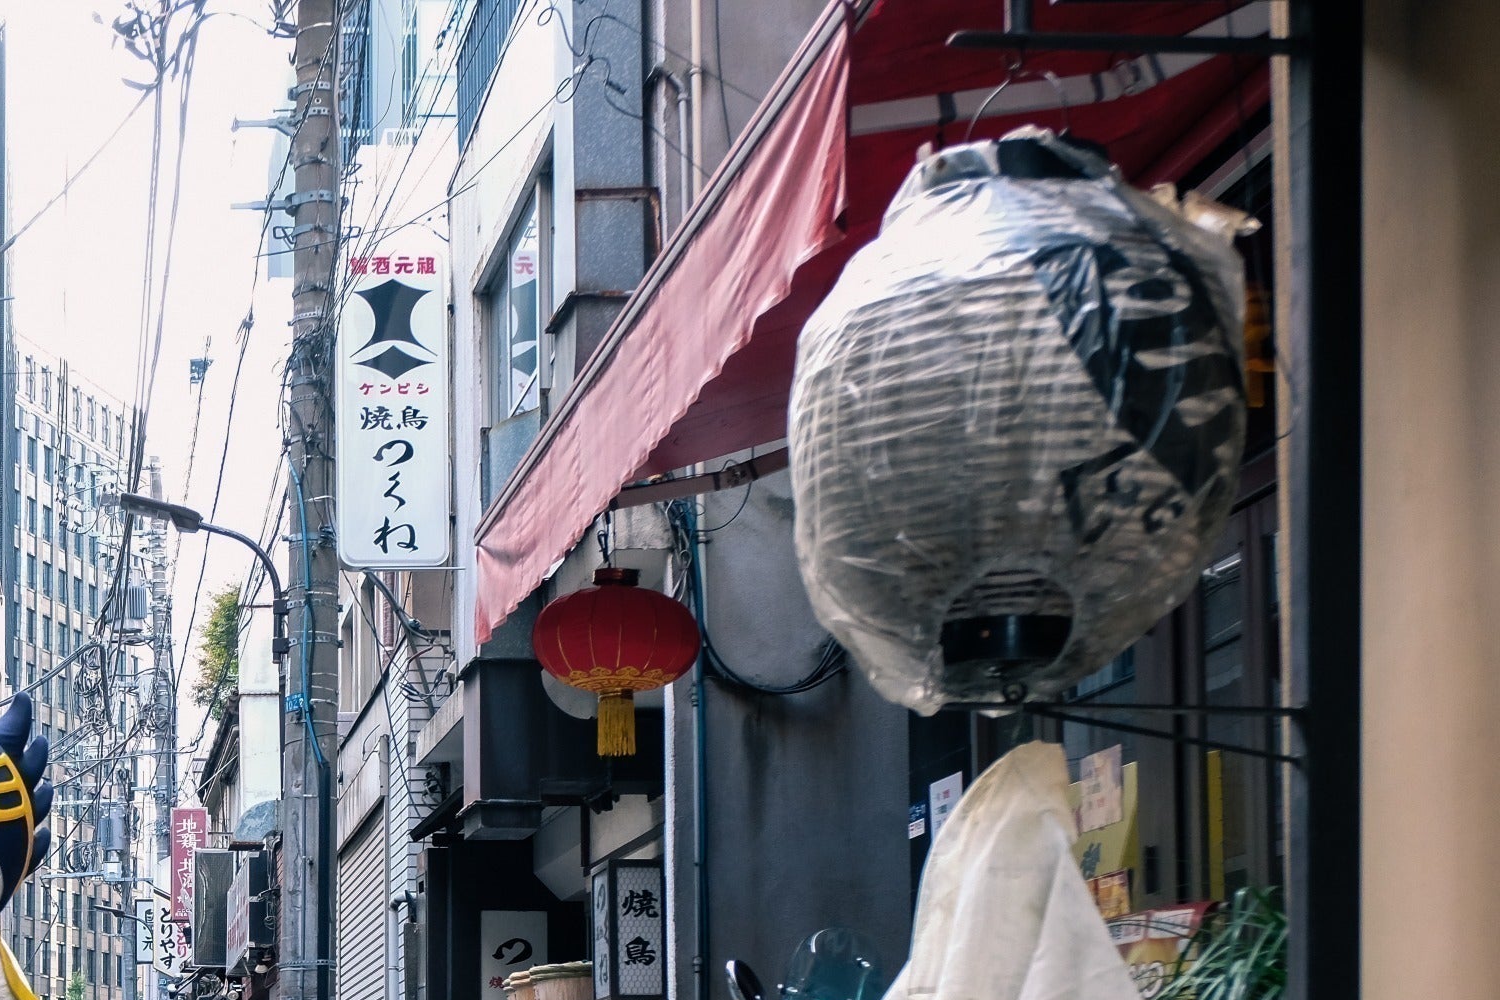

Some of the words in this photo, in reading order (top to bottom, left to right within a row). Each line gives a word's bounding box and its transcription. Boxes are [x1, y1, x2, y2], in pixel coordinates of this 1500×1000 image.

[360, 405, 428, 431] 焼鳥
[373, 439, 418, 553] つくね
[160, 907, 175, 970] とりやす
[622, 890, 659, 966] 焼鳥
